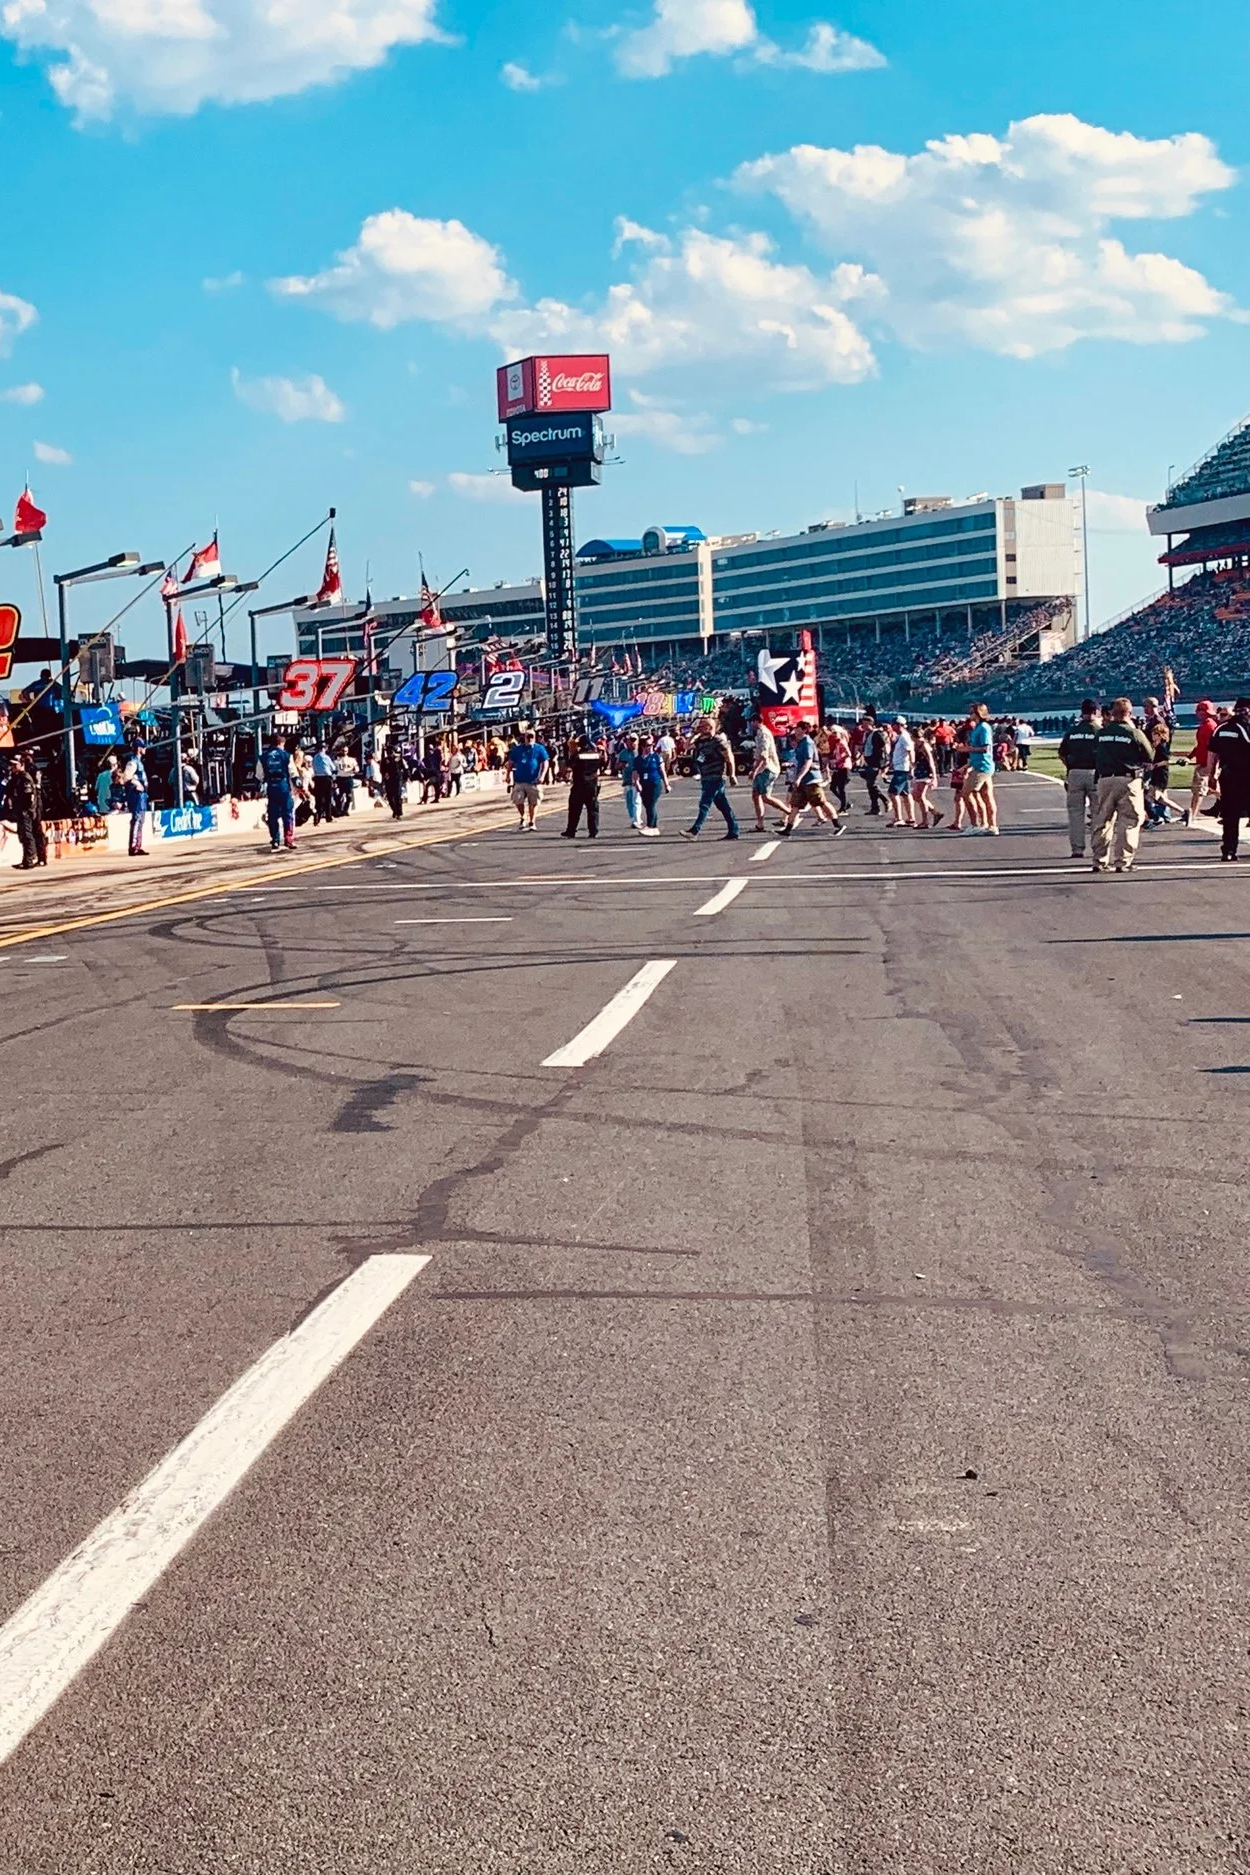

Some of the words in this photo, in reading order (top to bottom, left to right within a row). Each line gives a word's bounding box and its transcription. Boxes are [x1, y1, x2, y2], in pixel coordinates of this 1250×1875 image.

[511, 427, 583, 447] Spectrum
[557, 487, 568, 497] 24
[281, 661, 355, 709] 37
[393, 671, 457, 712] 42
[482, 671, 525, 709] 2
